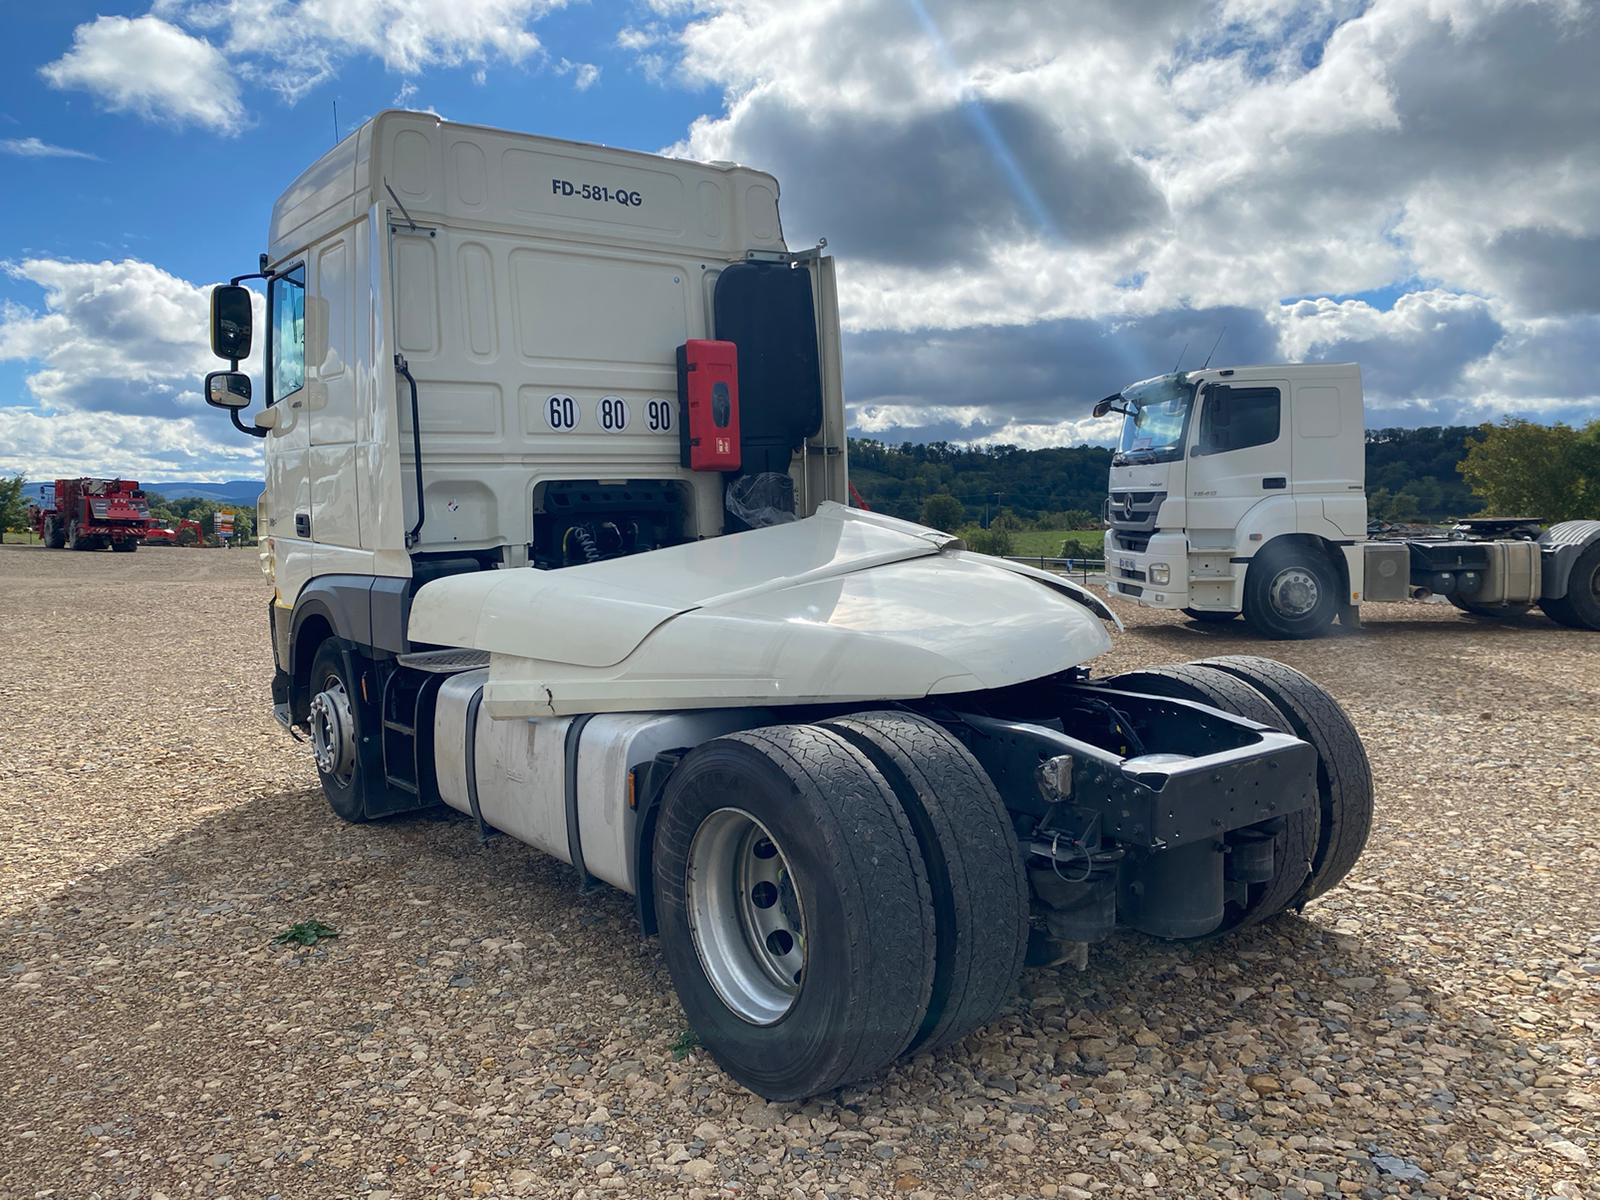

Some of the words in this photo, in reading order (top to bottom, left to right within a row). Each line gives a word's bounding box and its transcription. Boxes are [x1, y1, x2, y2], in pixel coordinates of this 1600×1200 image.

[552, 179, 642, 207] FD-581-QG
[549, 397, 574, 428] 60
[602, 399, 625, 429] 80
[648, 401, 670, 430] 90
